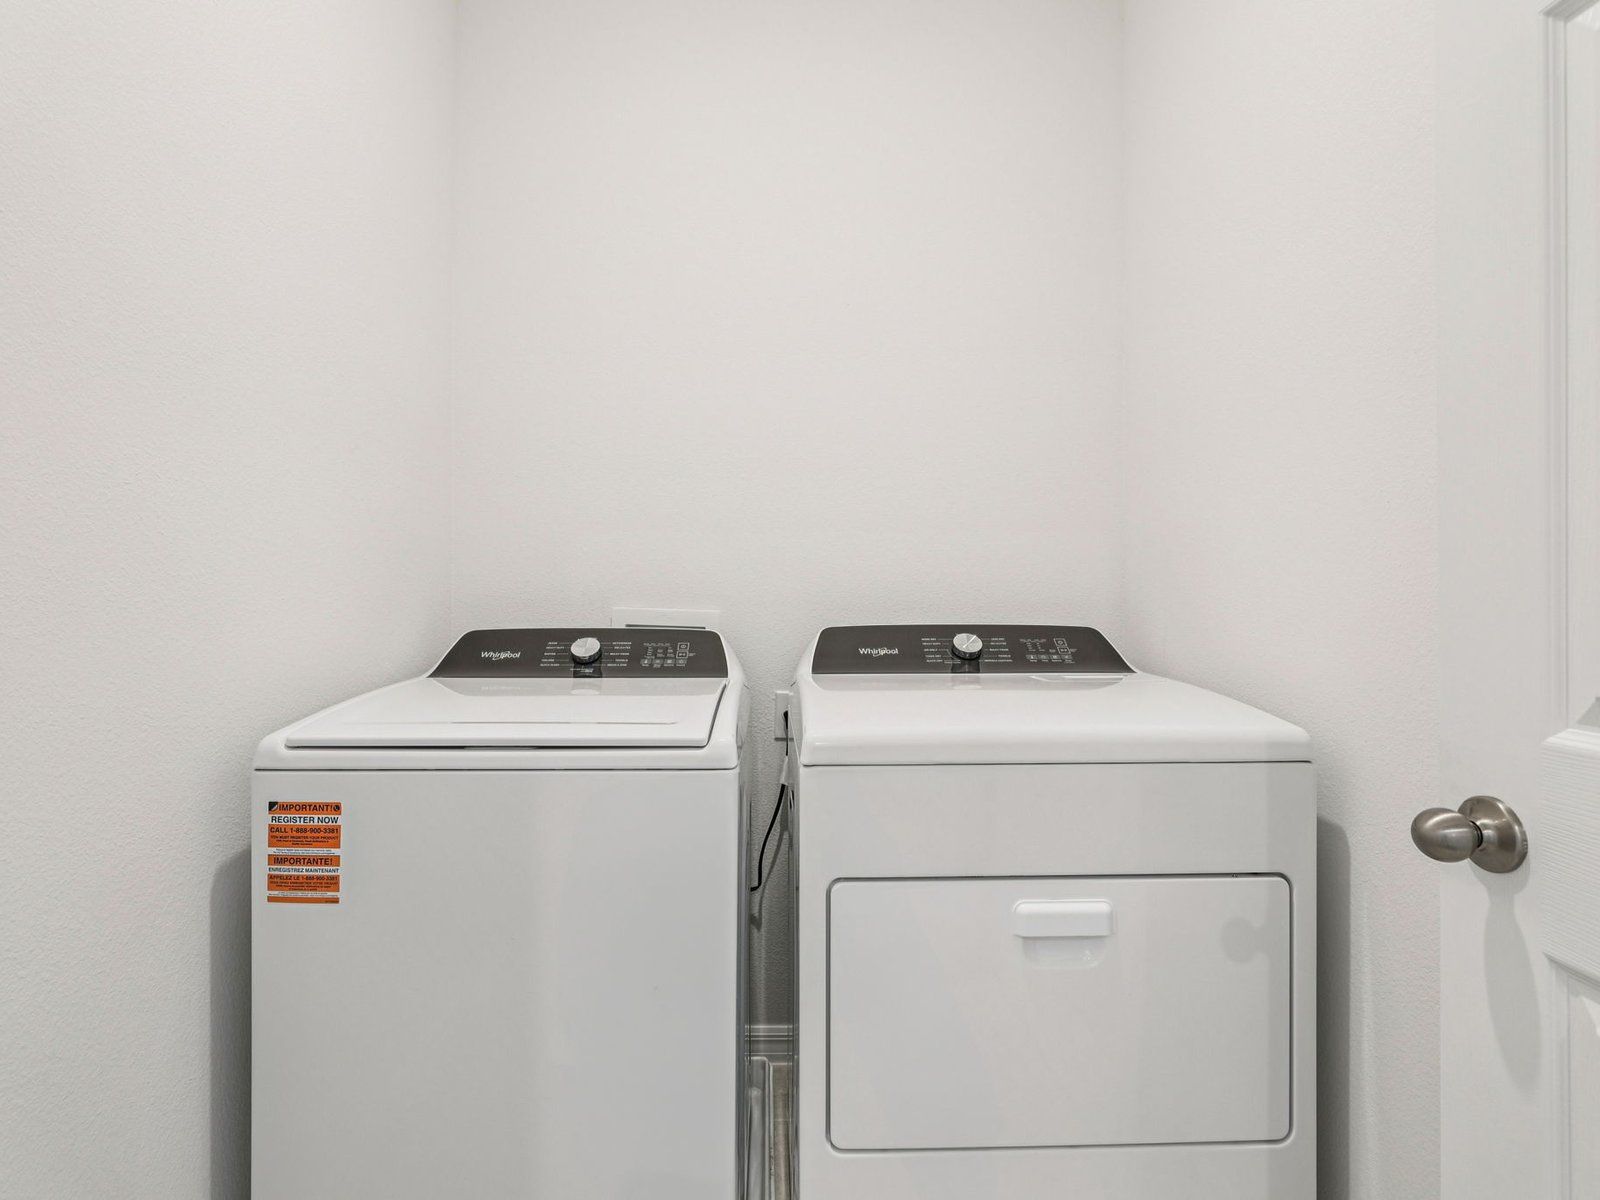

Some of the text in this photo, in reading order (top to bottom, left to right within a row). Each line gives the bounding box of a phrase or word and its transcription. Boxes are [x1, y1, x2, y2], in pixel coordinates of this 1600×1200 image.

[481, 651, 521, 660] Whirlpool
[858, 647, 898, 657] Whirlpool
[278, 804, 333, 812] IMPORTANT!
[273, 857, 333, 865] IMPORTANTE!
